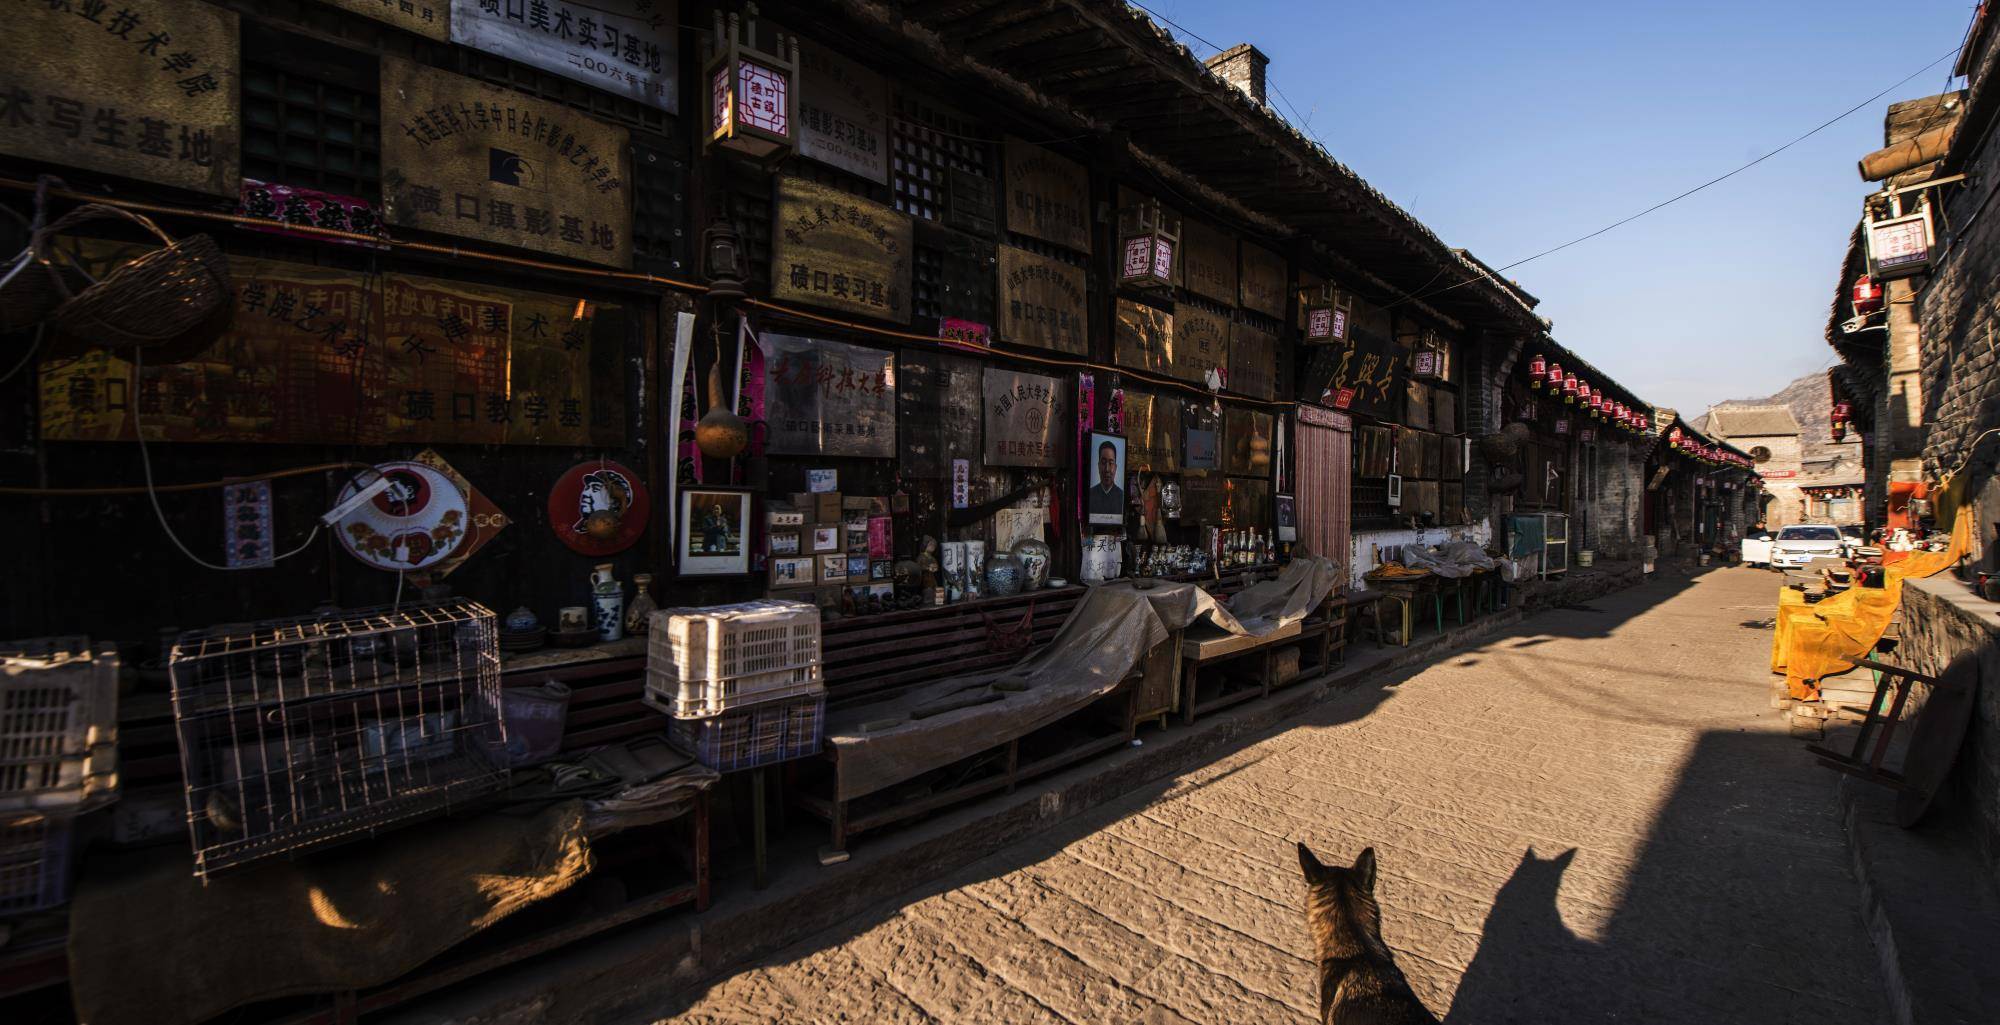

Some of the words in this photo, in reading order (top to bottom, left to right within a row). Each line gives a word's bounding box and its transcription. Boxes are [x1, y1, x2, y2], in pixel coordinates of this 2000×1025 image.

[411, 184, 615, 252] 碛口摄影基地
